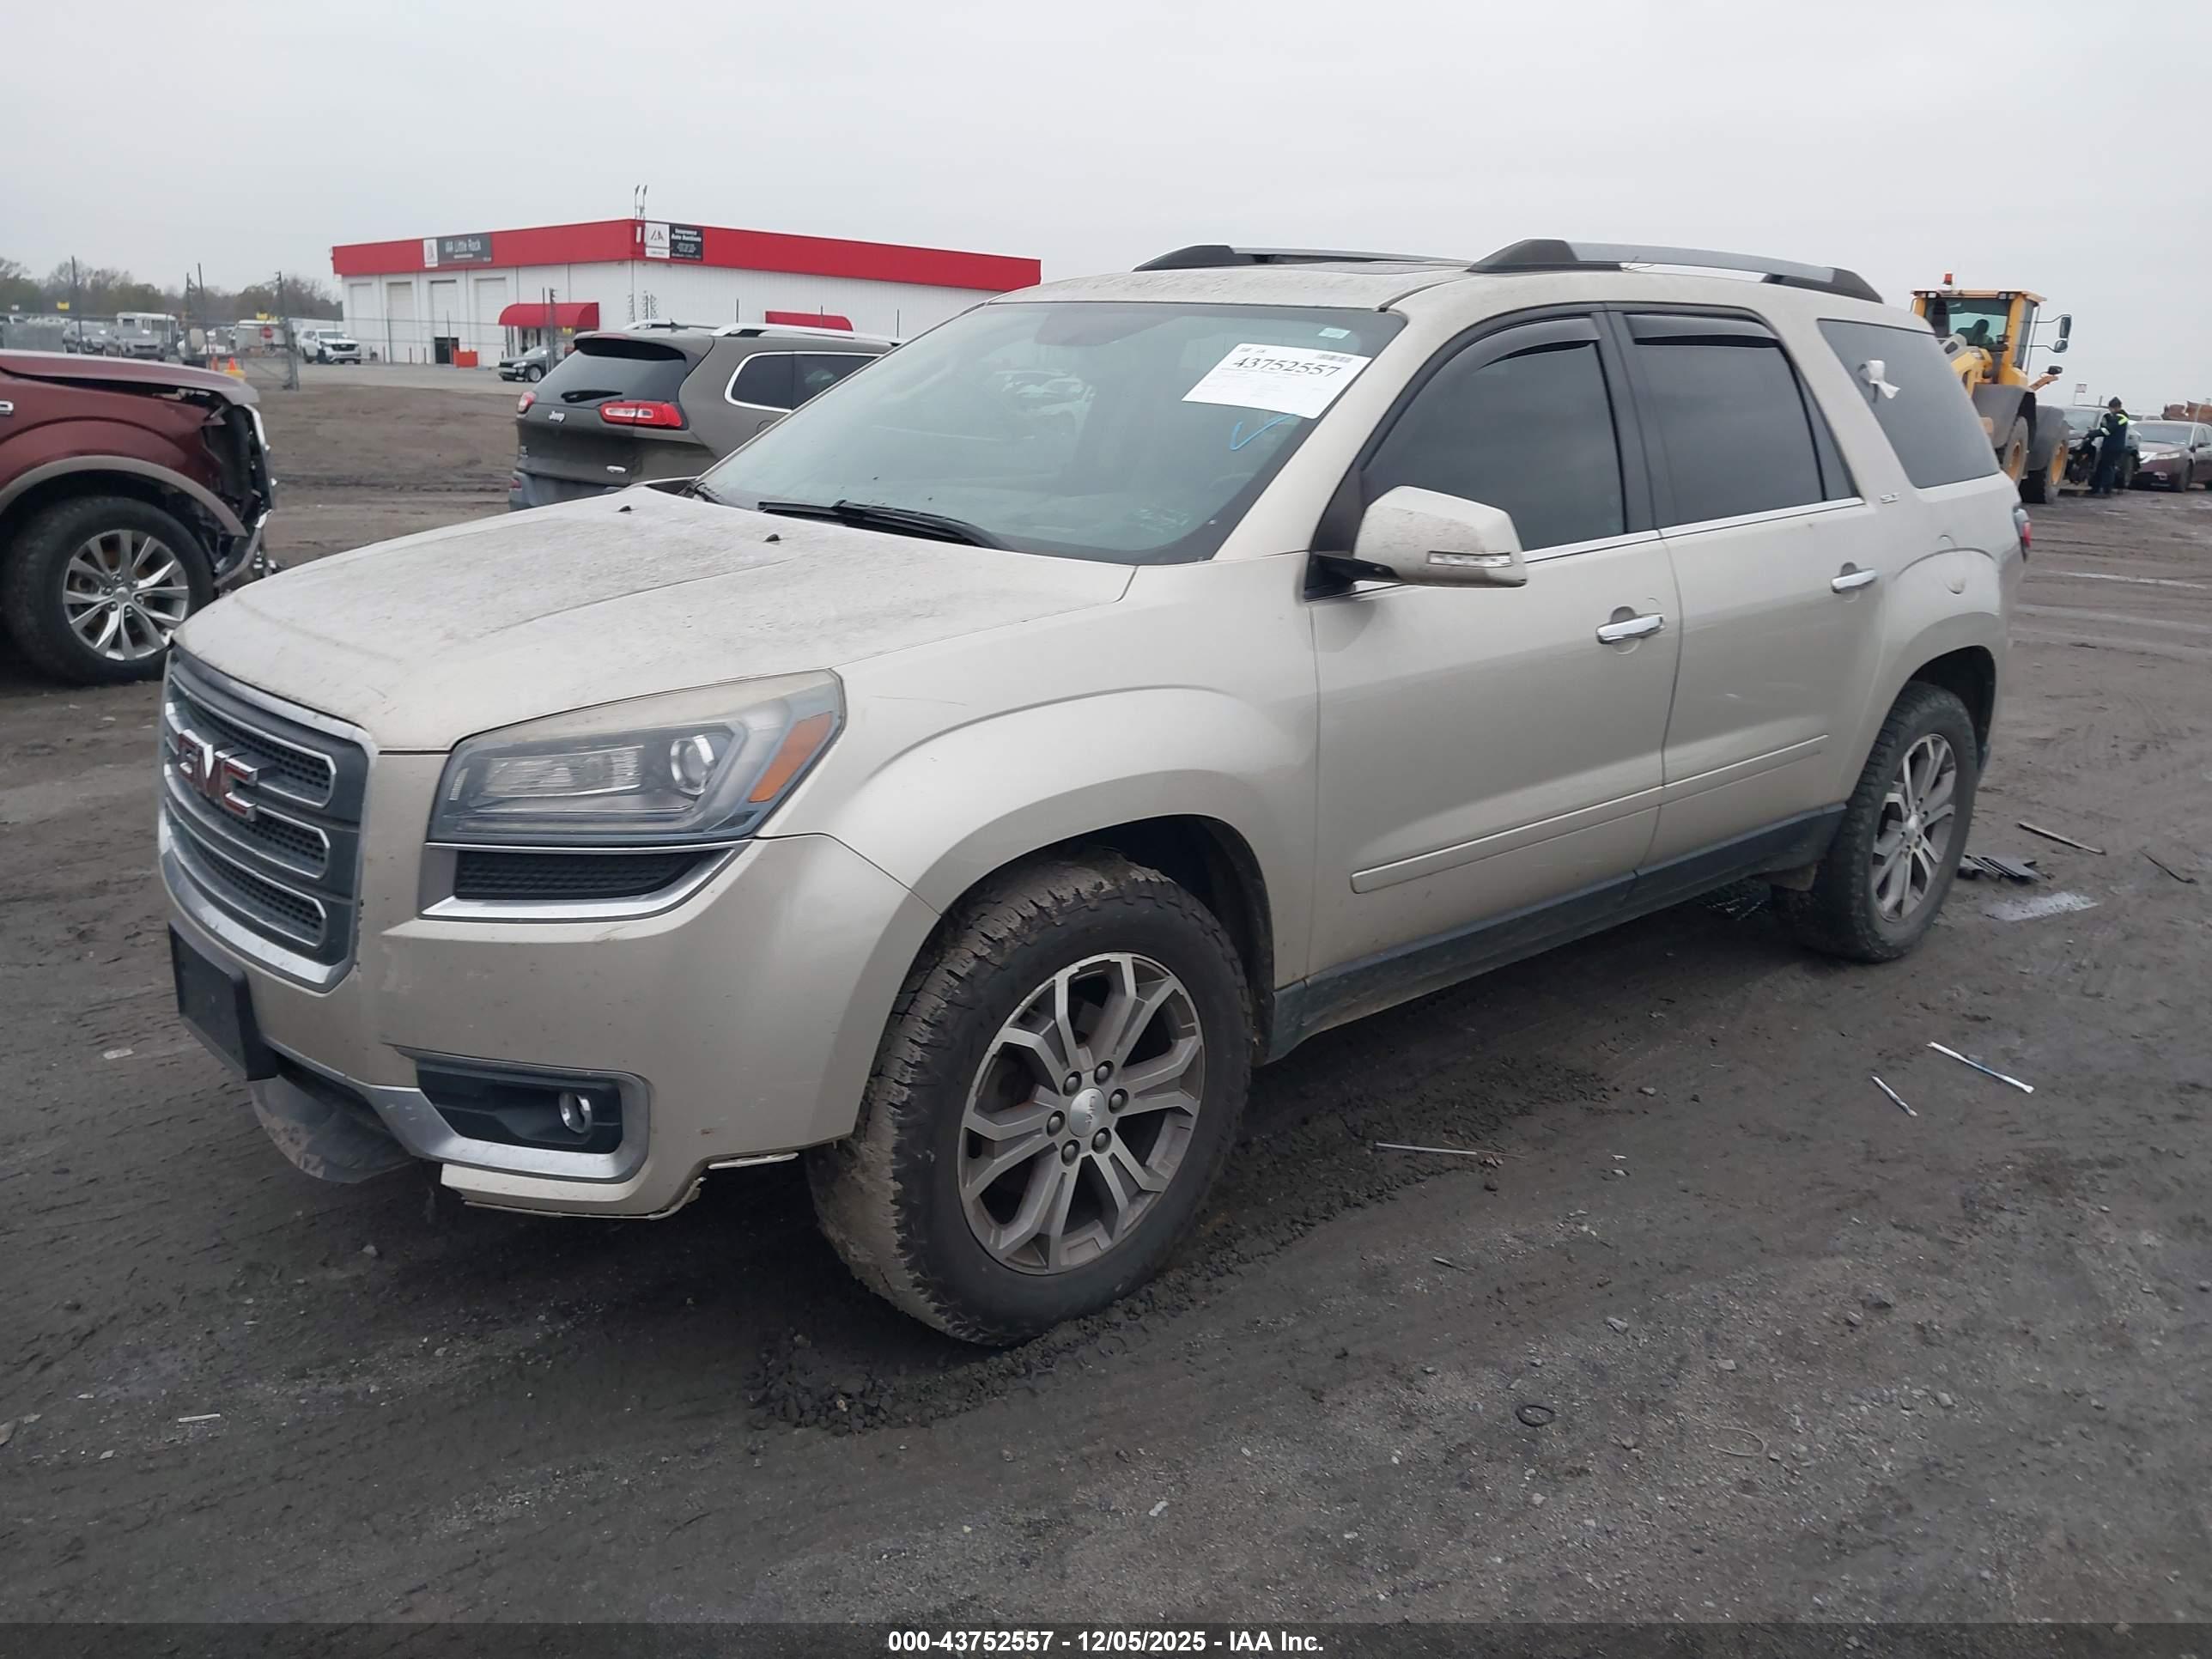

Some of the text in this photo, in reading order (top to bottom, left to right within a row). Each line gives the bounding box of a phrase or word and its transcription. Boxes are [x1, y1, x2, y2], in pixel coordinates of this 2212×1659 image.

[1233, 356, 1342, 378] 43752557
[549, 410, 565, 423] Jeep
[177, 728, 258, 823] GMC
